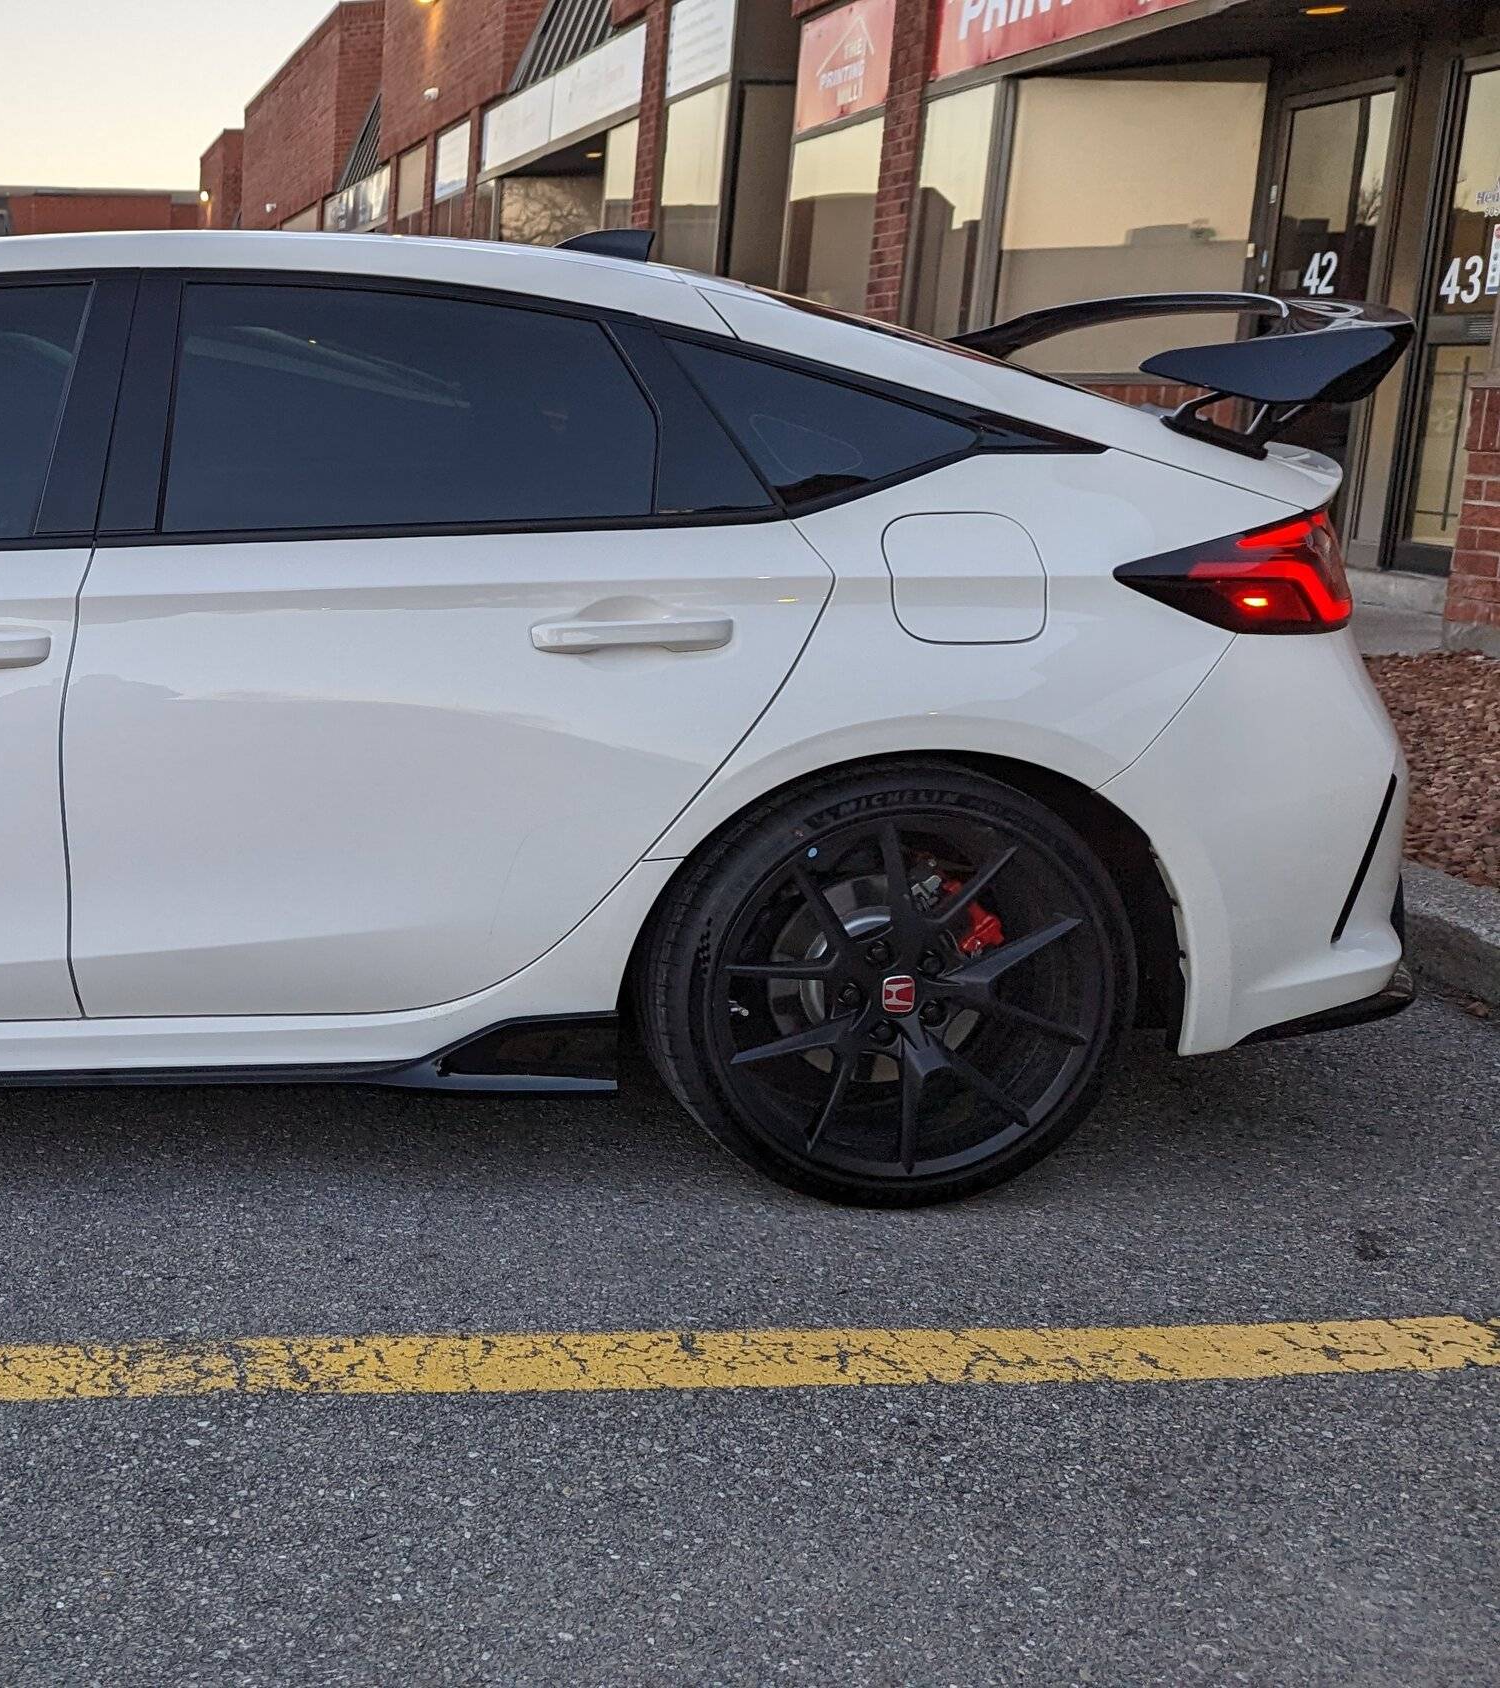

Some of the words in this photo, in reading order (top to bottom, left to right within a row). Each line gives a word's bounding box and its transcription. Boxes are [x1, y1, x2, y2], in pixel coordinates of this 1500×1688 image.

[1303, 251, 1338, 295] 42
[1440, 255, 1483, 304] 43
[834, 789, 961, 816] MICHELIN
